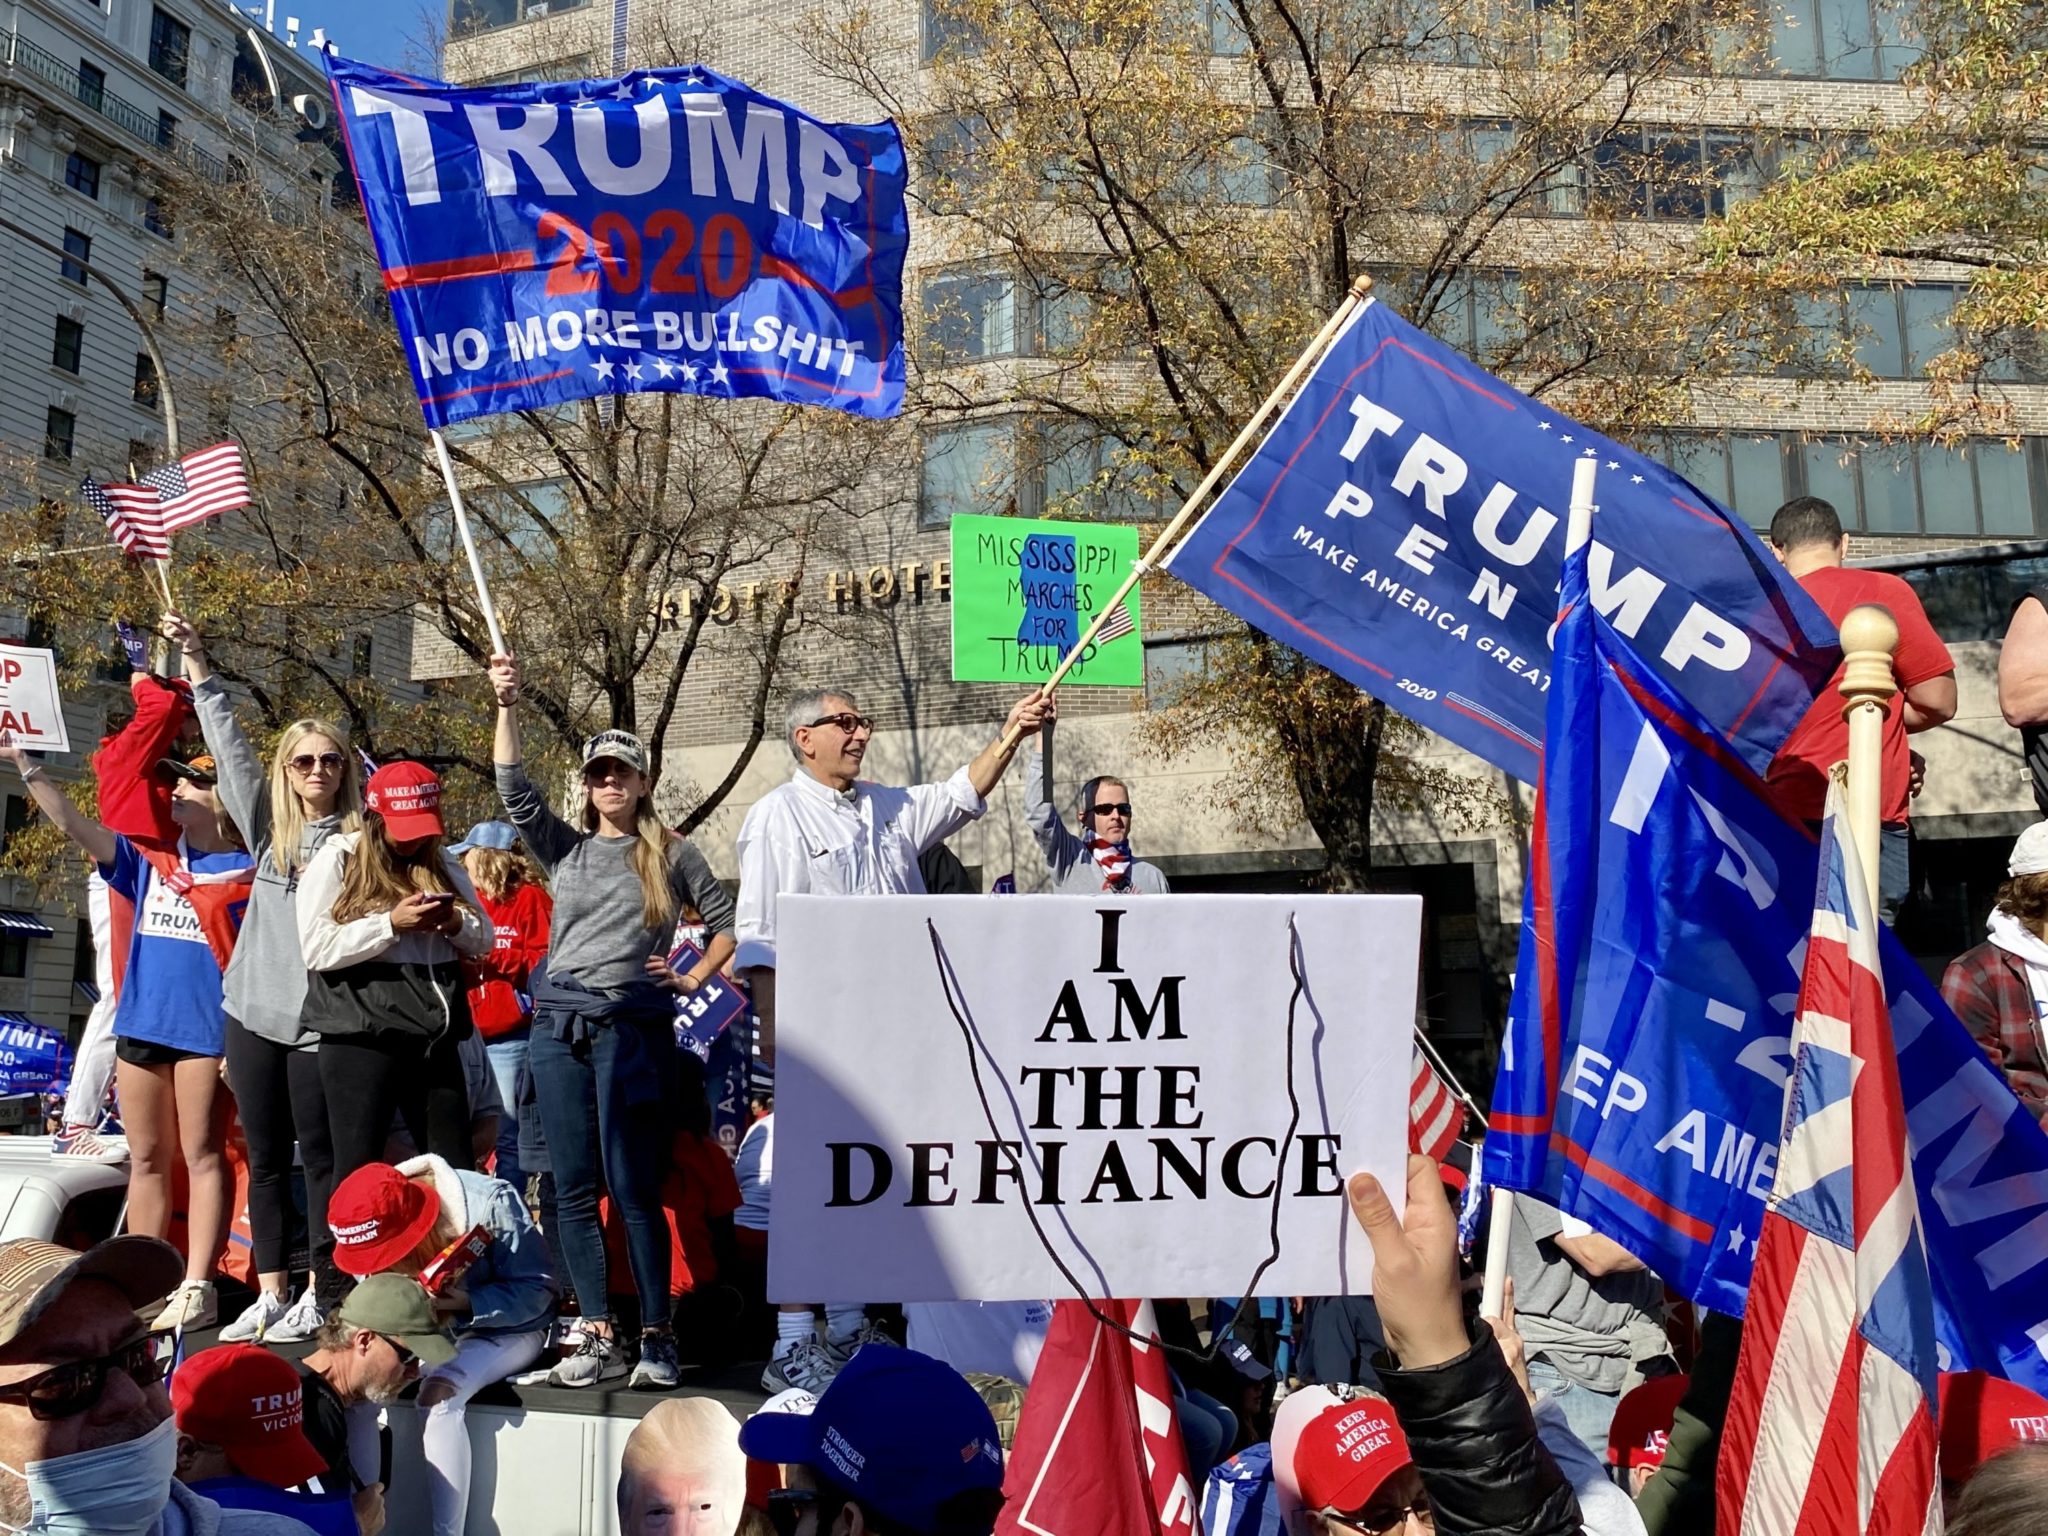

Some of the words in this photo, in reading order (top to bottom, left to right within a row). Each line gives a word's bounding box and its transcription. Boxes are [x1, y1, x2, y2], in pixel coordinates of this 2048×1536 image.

[350, 86, 862, 231] TRUMP
[537, 209, 753, 299] 2020
[415, 327, 489, 379] NO
[503, 308, 642, 363] MORE
[654, 310, 864, 378] BULLSHIT
[977, 532, 1118, 575] MISSISSIPPI
[1339, 394, 1752, 672] TRUMP
[827, 560, 951, 603] HOTE
[1324, 481, 1558, 652] PEN
[1007, 577, 1093, 612] MARCHES
[1293, 525, 1359, 574] MAKE
[1360, 569, 1470, 642] AMERICA
[1476, 636, 1552, 693] GREAT
[1033, 616, 1068, 640] FOR
[987, 636, 1098, 677] TRUMP
[1396, 678, 1438, 702] 2020
[588, 733, 637, 760] TRUMP
[385, 786, 410, 798] MAKE
[410, 782, 441, 796] AMERICA
[391, 798, 418, 811] GREAT
[418, 796, 439, 809] AGAIN
[150, 911, 204, 932] TRUM
[1093, 909, 1127, 973] I
[1034, 976, 1188, 1043] AM
[1020, 1065, 1204, 1131] THE
[824, 1134, 1345, 1208] DEFIANCE
[349, 1230, 379, 1245] AGAIN
[780, 1393, 818, 1413] Tru
[1334, 1410, 1367, 1434] KEEP
[826, 1426, 866, 1469] STRONGER
[1335, 1418, 1391, 1457] AMERICA
[1350, 1432, 1392, 1462] GREAT
[1644, 1429, 1669, 1455] 45
[821, 1438, 860, 1482] TOGETHER
